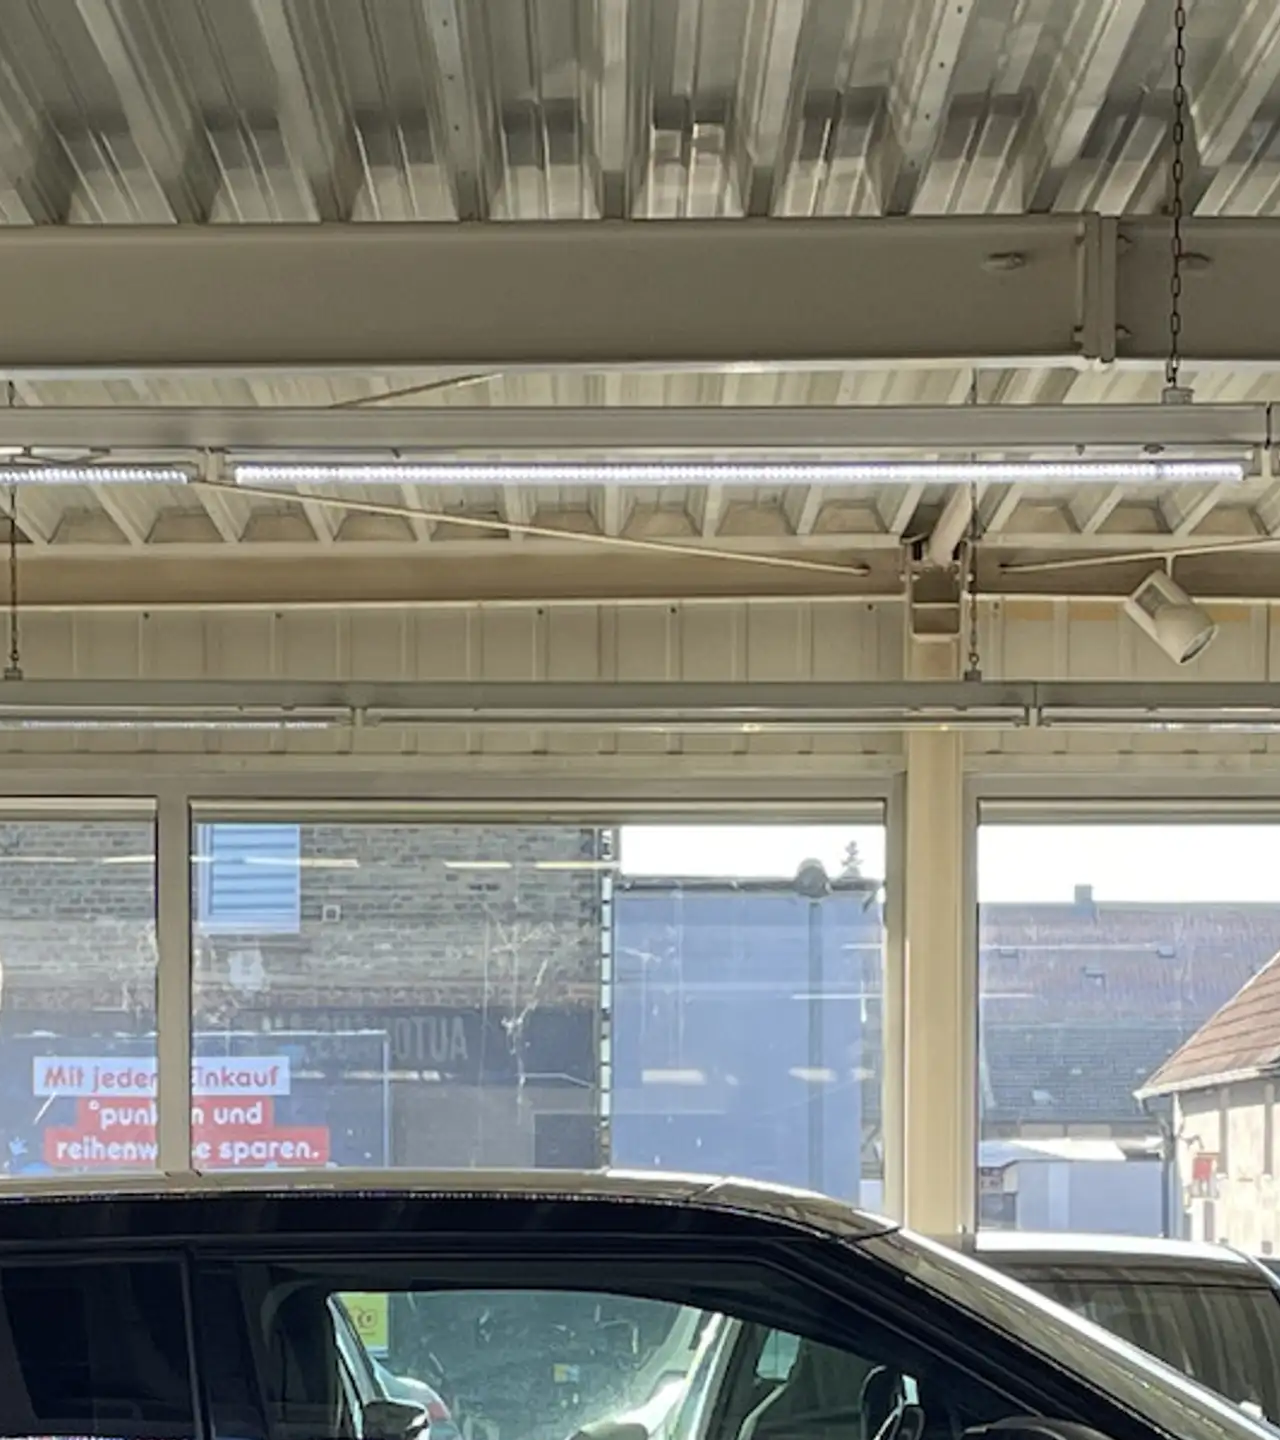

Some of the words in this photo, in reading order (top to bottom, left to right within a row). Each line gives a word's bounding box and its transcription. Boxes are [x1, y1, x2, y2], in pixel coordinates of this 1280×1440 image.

[43, 1066, 84, 1088] Mit
[192, 1065, 280, 1088] inkauf
[214, 1102, 262, 1124] und
[218, 1141, 320, 1164] sparen.
